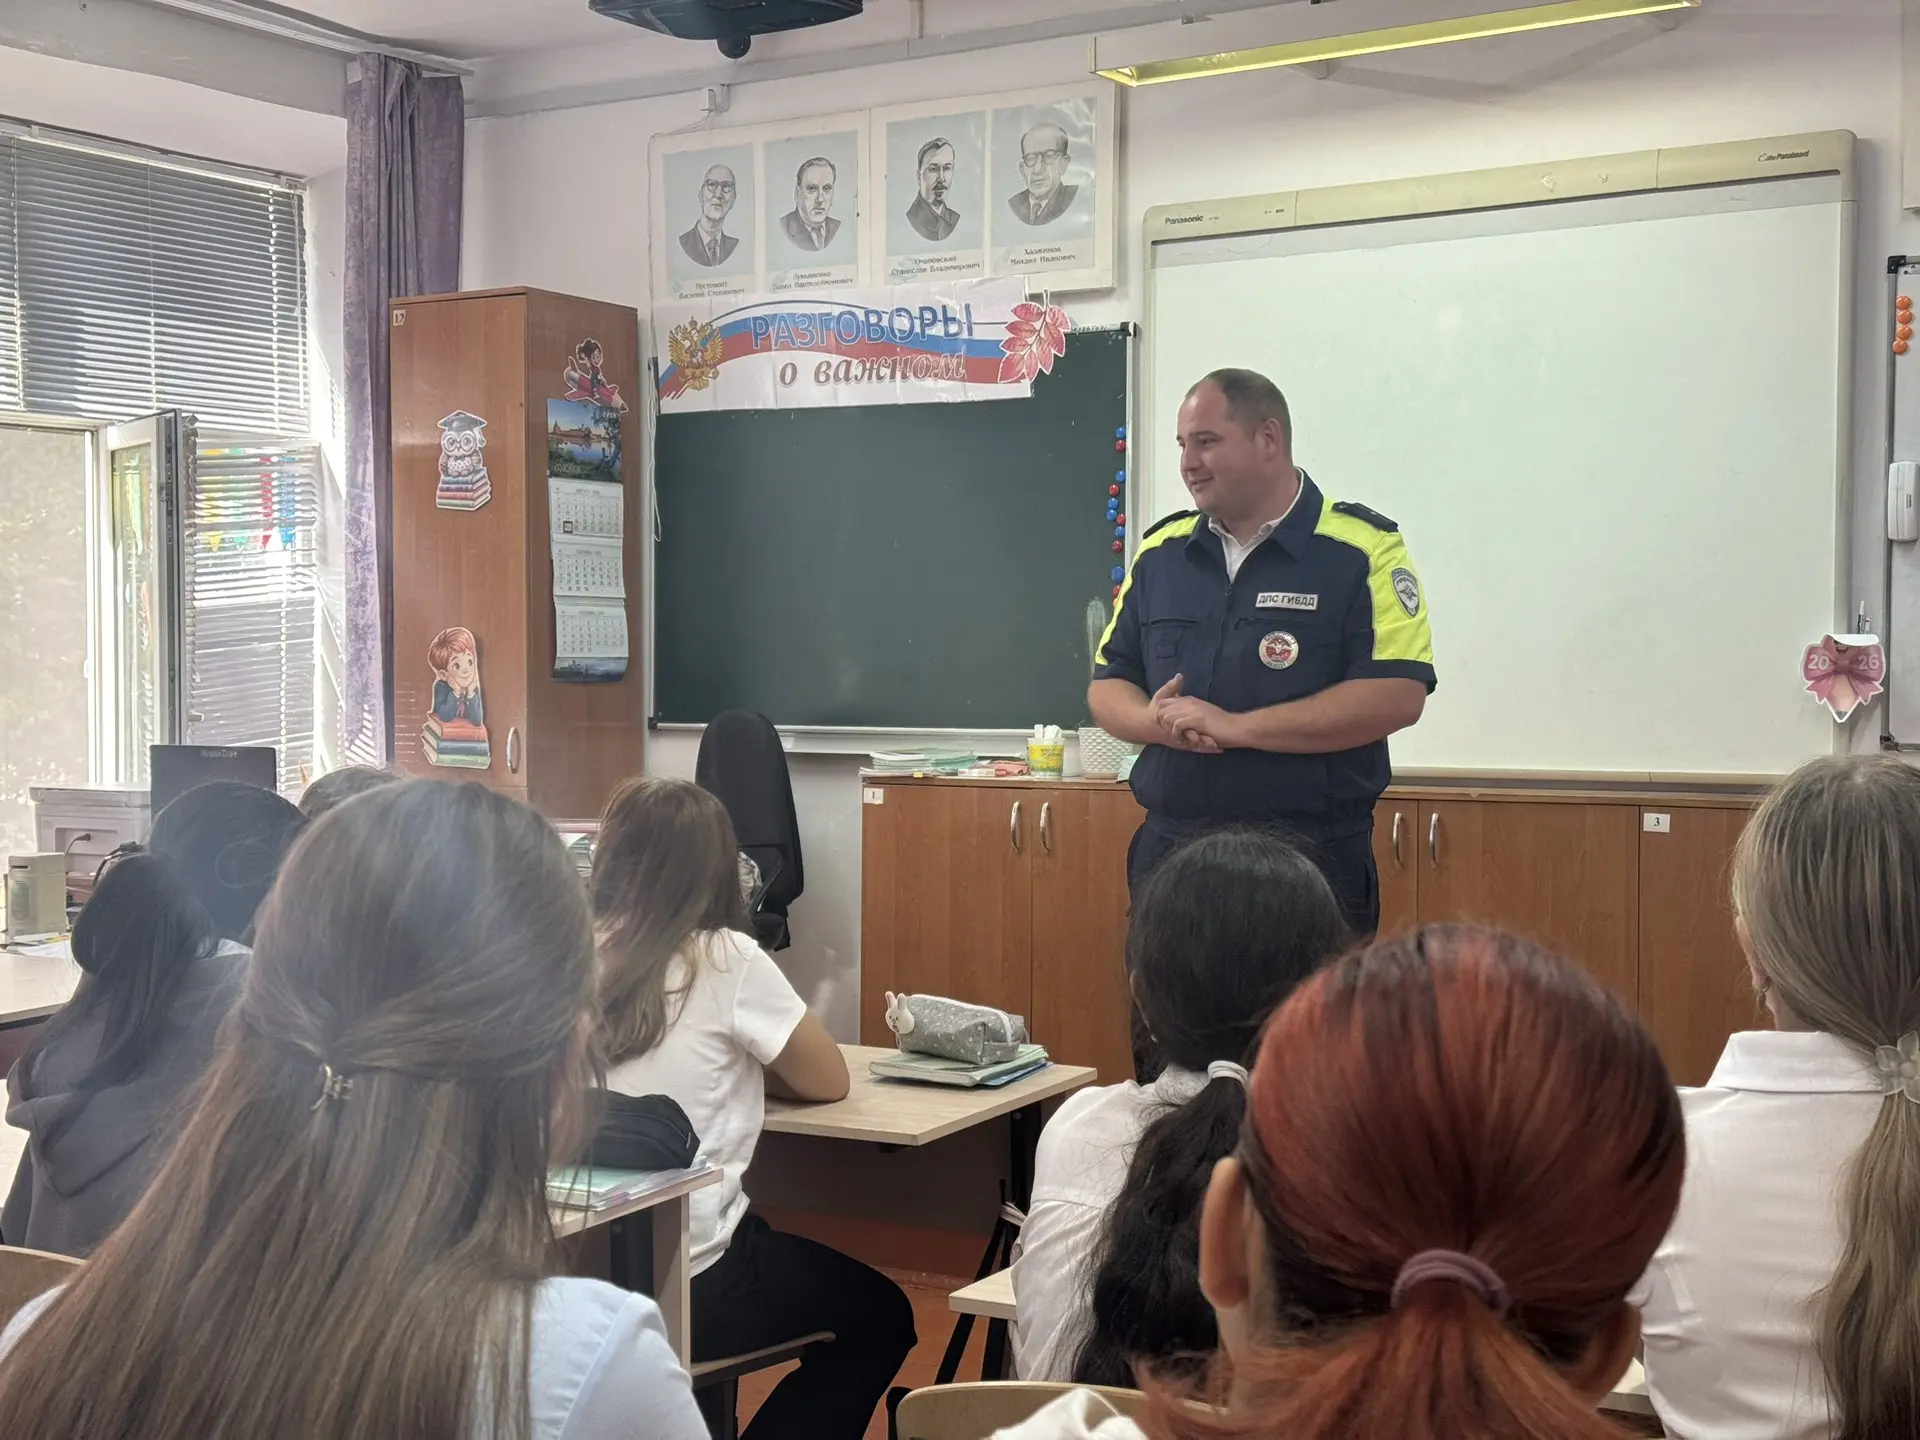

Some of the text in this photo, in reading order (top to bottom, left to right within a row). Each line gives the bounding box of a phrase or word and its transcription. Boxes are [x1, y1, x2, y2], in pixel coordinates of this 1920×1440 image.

[1164, 214, 1204, 225] Panasonic
[1010, 254, 1076, 266] Михаил Иванович
[891, 266, 927, 276] Станислав
[707, 288, 744, 297] Степанович
[751, 302, 974, 350] РАЗГОВОРЫ
[779, 351, 966, 388] о важном
[1258, 594, 1315, 606] ДПС ГИБДД
[1807, 654, 1880, 671] 20 26
[1654, 817, 1660, 827] 3
